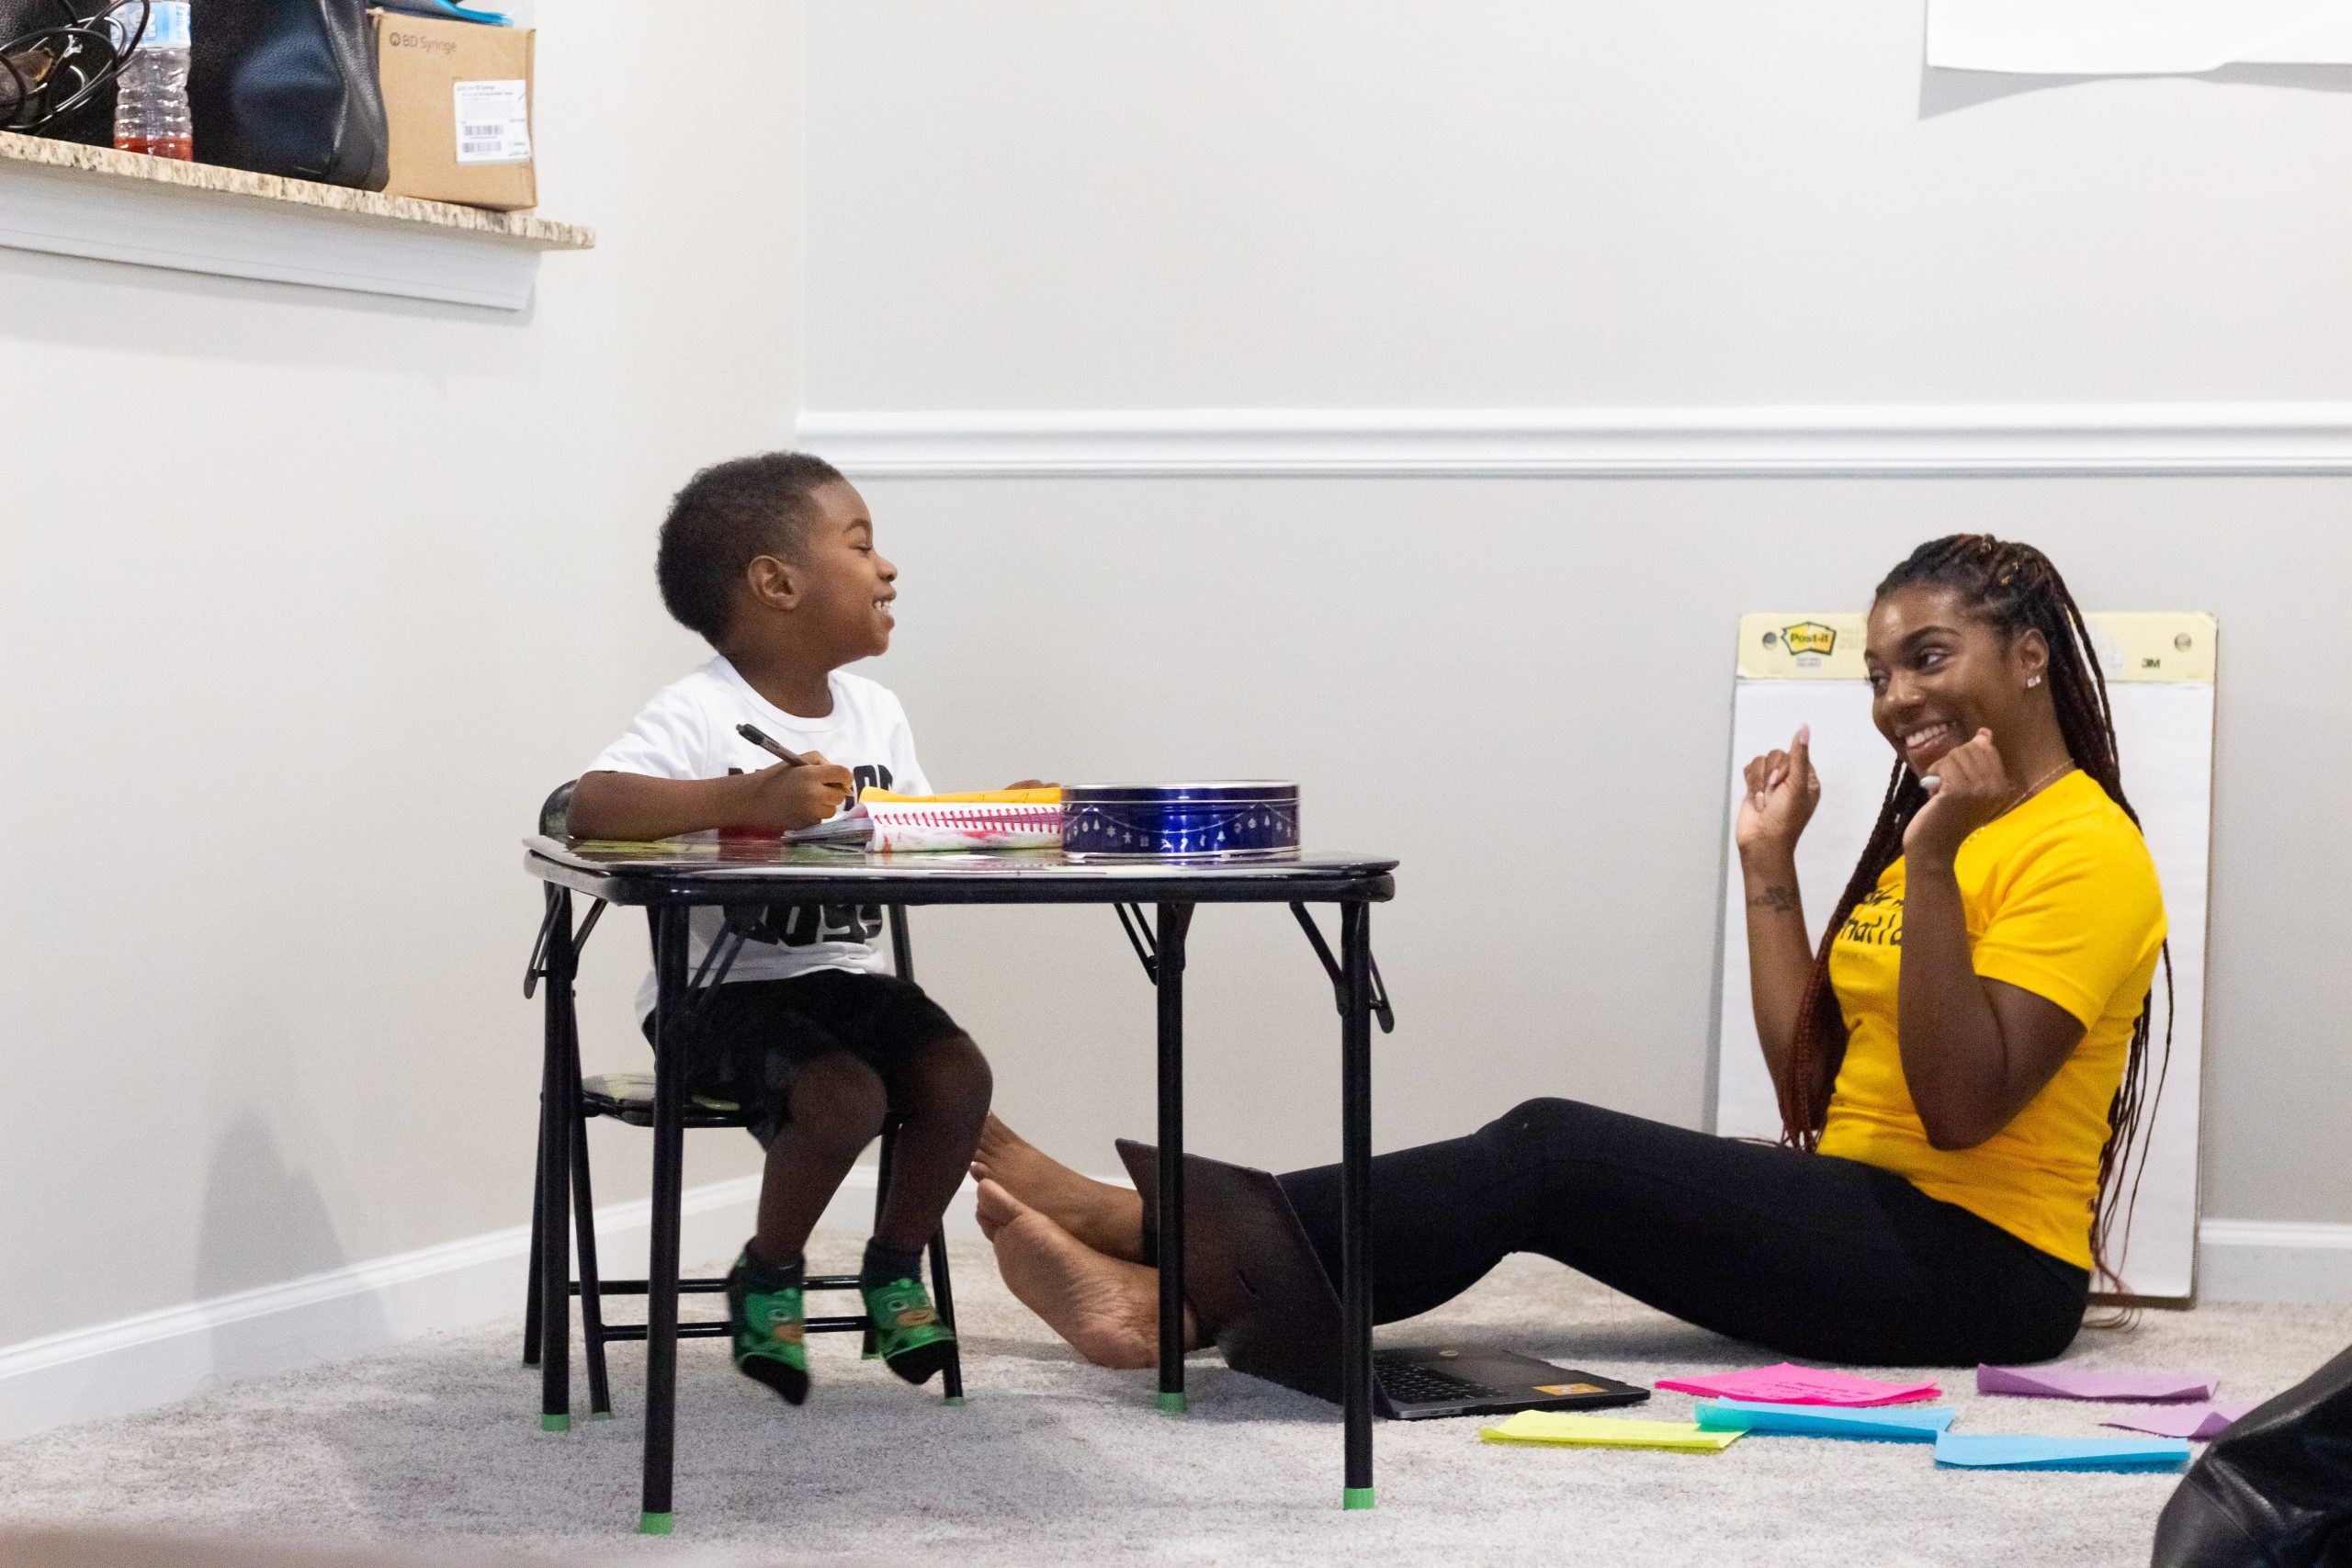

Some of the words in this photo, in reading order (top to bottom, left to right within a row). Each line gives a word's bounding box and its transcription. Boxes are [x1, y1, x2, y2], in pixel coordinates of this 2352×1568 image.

[403, 35, 418, 47] BD
[421, 36, 457, 54] Syringe
[1791, 633, 1830, 643] Post-it
[2142, 659, 2161, 669] 3M
